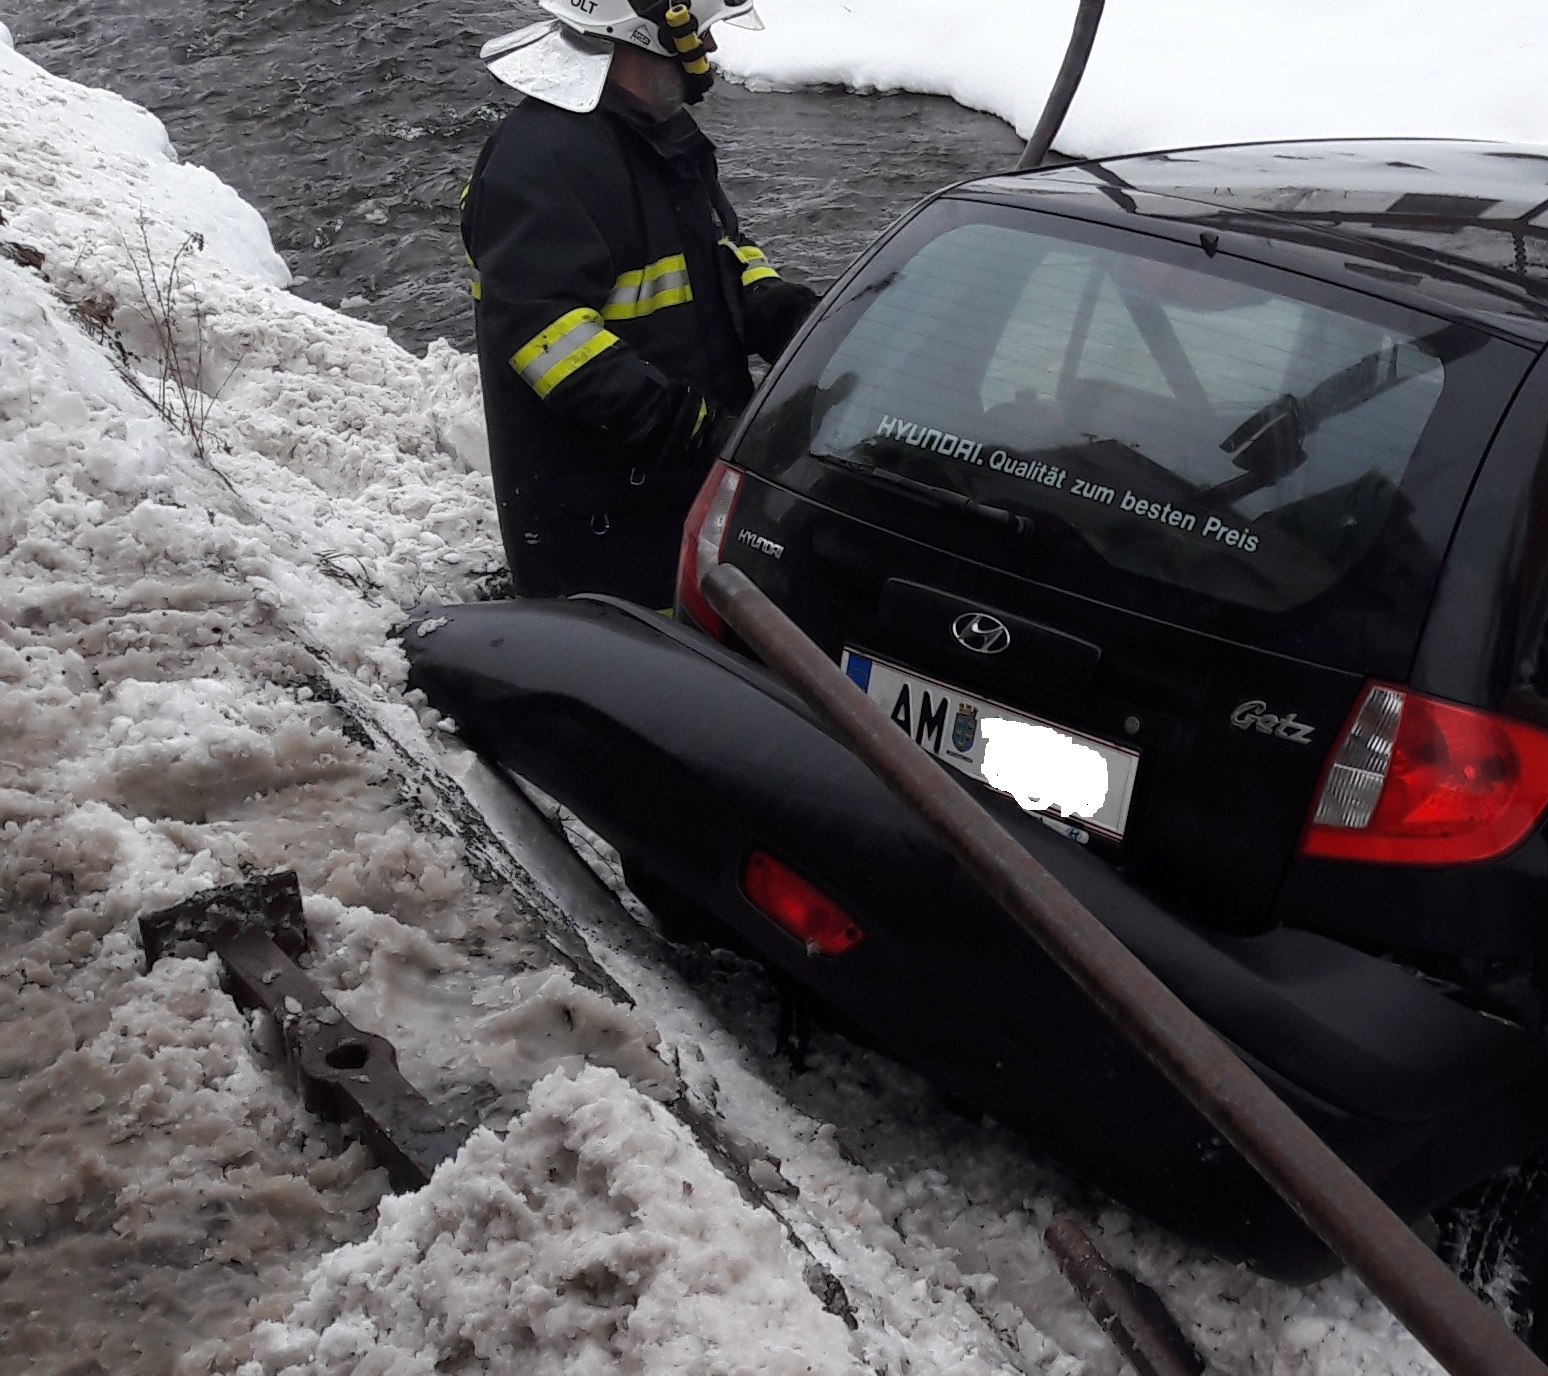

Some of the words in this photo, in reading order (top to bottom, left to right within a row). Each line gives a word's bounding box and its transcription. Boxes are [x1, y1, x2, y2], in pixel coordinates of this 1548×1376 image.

[989, 450, 1067, 489] Qualität
[1071, 478, 1116, 505] zum
[1120, 490, 1197, 532] besten
[1202, 516, 1260, 552] Preis
[737, 528, 785, 559] HYUNDAI
[890, 683, 949, 754] AM
[1230, 699, 1316, 745] Getz
